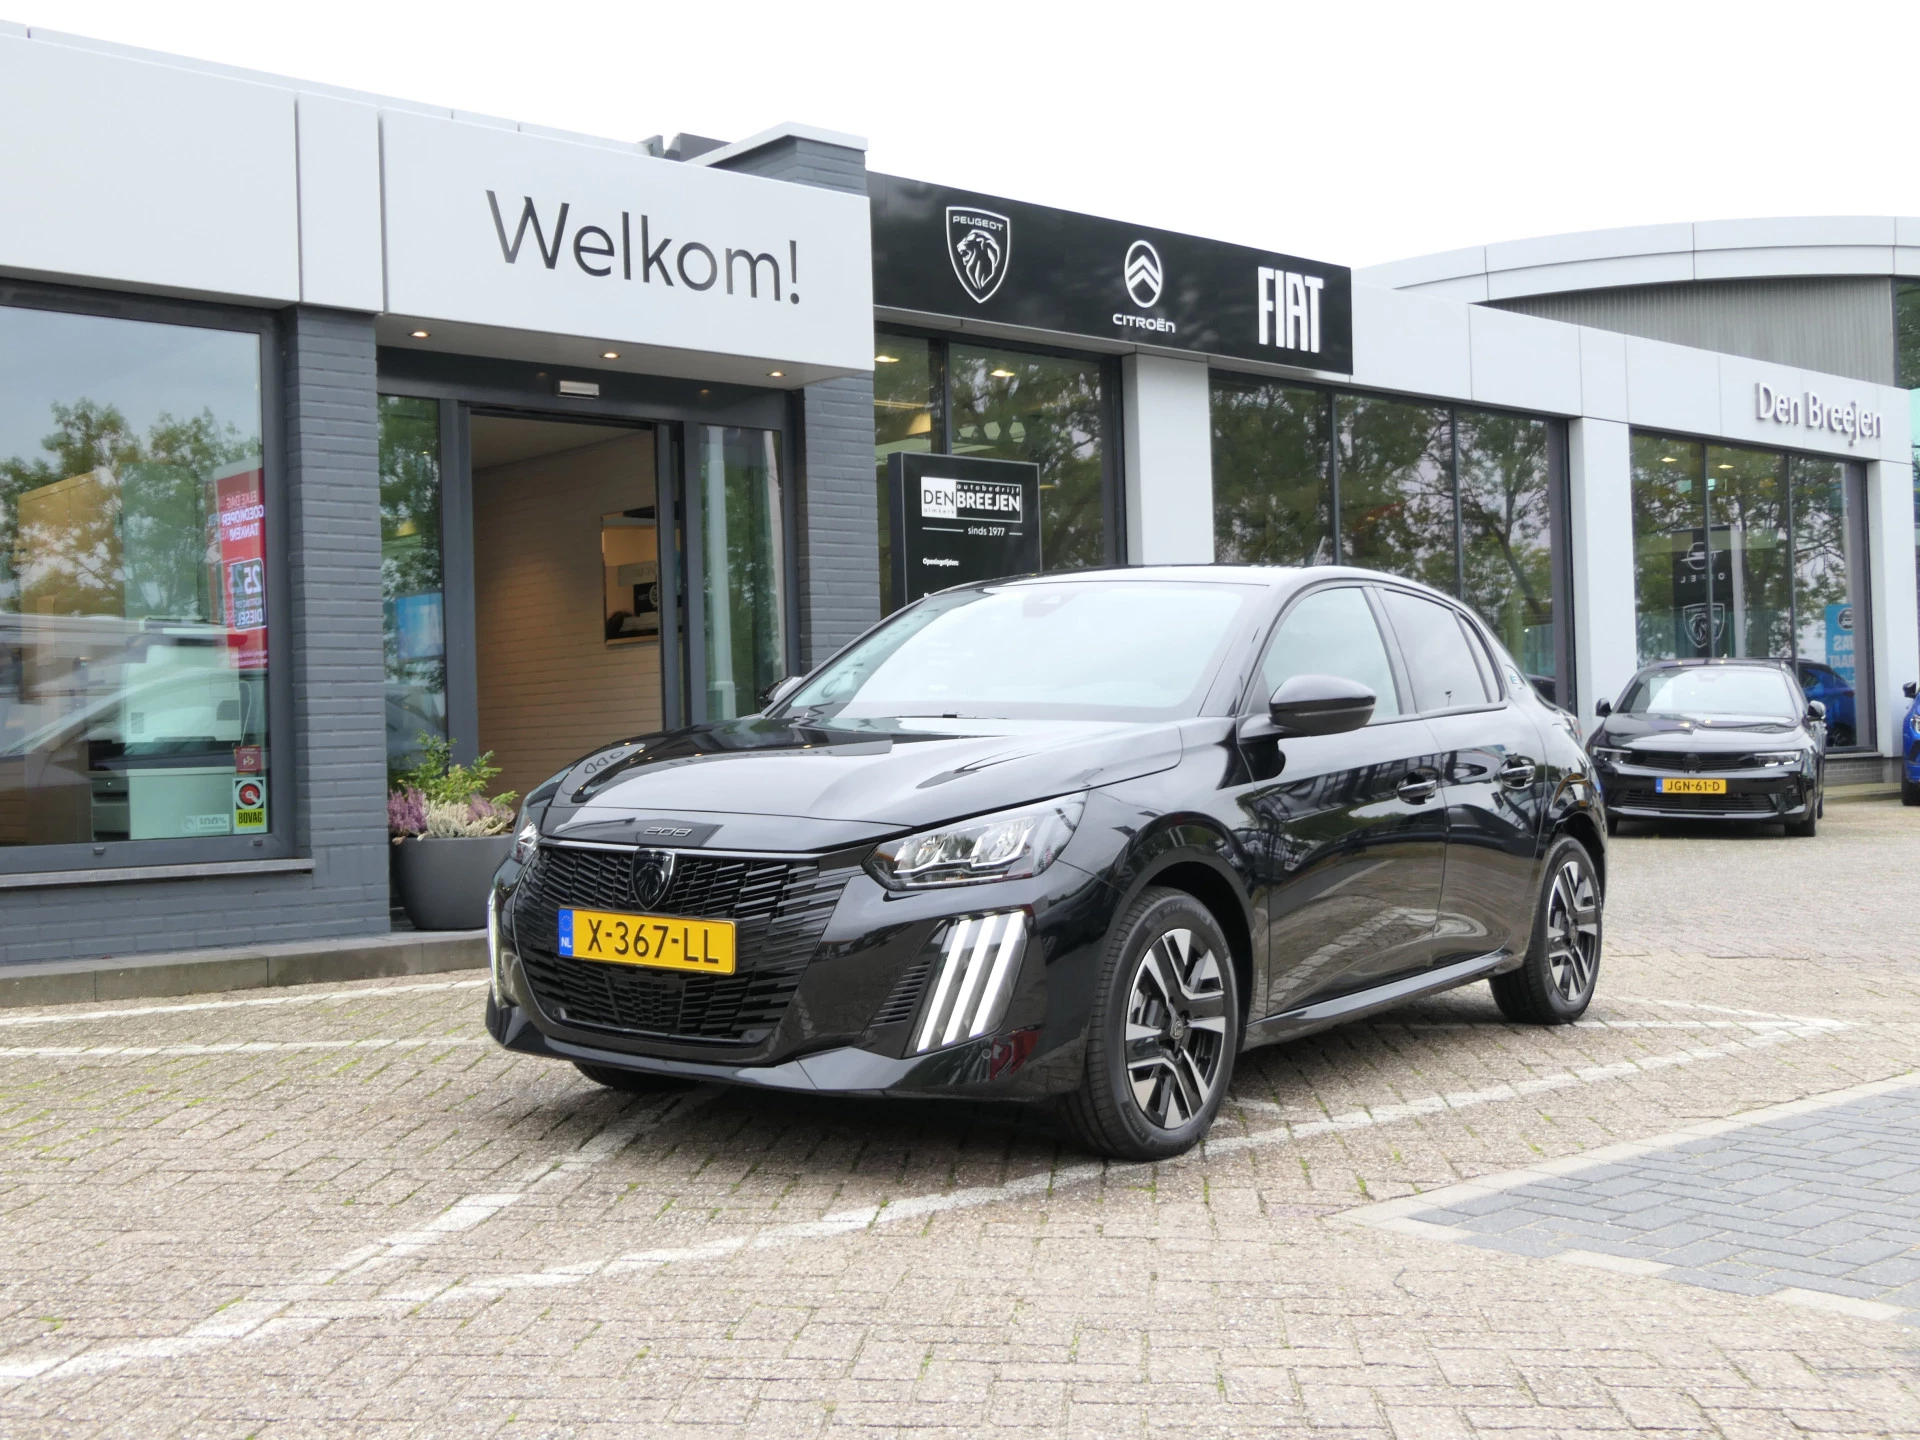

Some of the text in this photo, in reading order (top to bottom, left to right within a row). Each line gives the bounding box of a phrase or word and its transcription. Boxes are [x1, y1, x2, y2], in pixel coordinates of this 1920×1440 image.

[953, 215, 1004, 231] PEUGEOT
[486, 190, 800, 305] Welkom!
[1258, 266, 1324, 353] FIAT
[1112, 313, 1176, 334] CITROËN
[1754, 382, 1883, 447] Den Breejen
[957, 484, 1020, 494] autobedrijf
[924, 490, 1020, 512] DEN BREEJEN
[967, 526, 1005, 537] sinds 1977
[1667, 780, 1720, 792] JGN-61-D
[238, 811, 263, 824] BOVAG
[644, 826, 692, 837] 208
[561, 918, 719, 964] NL X-367-LL
